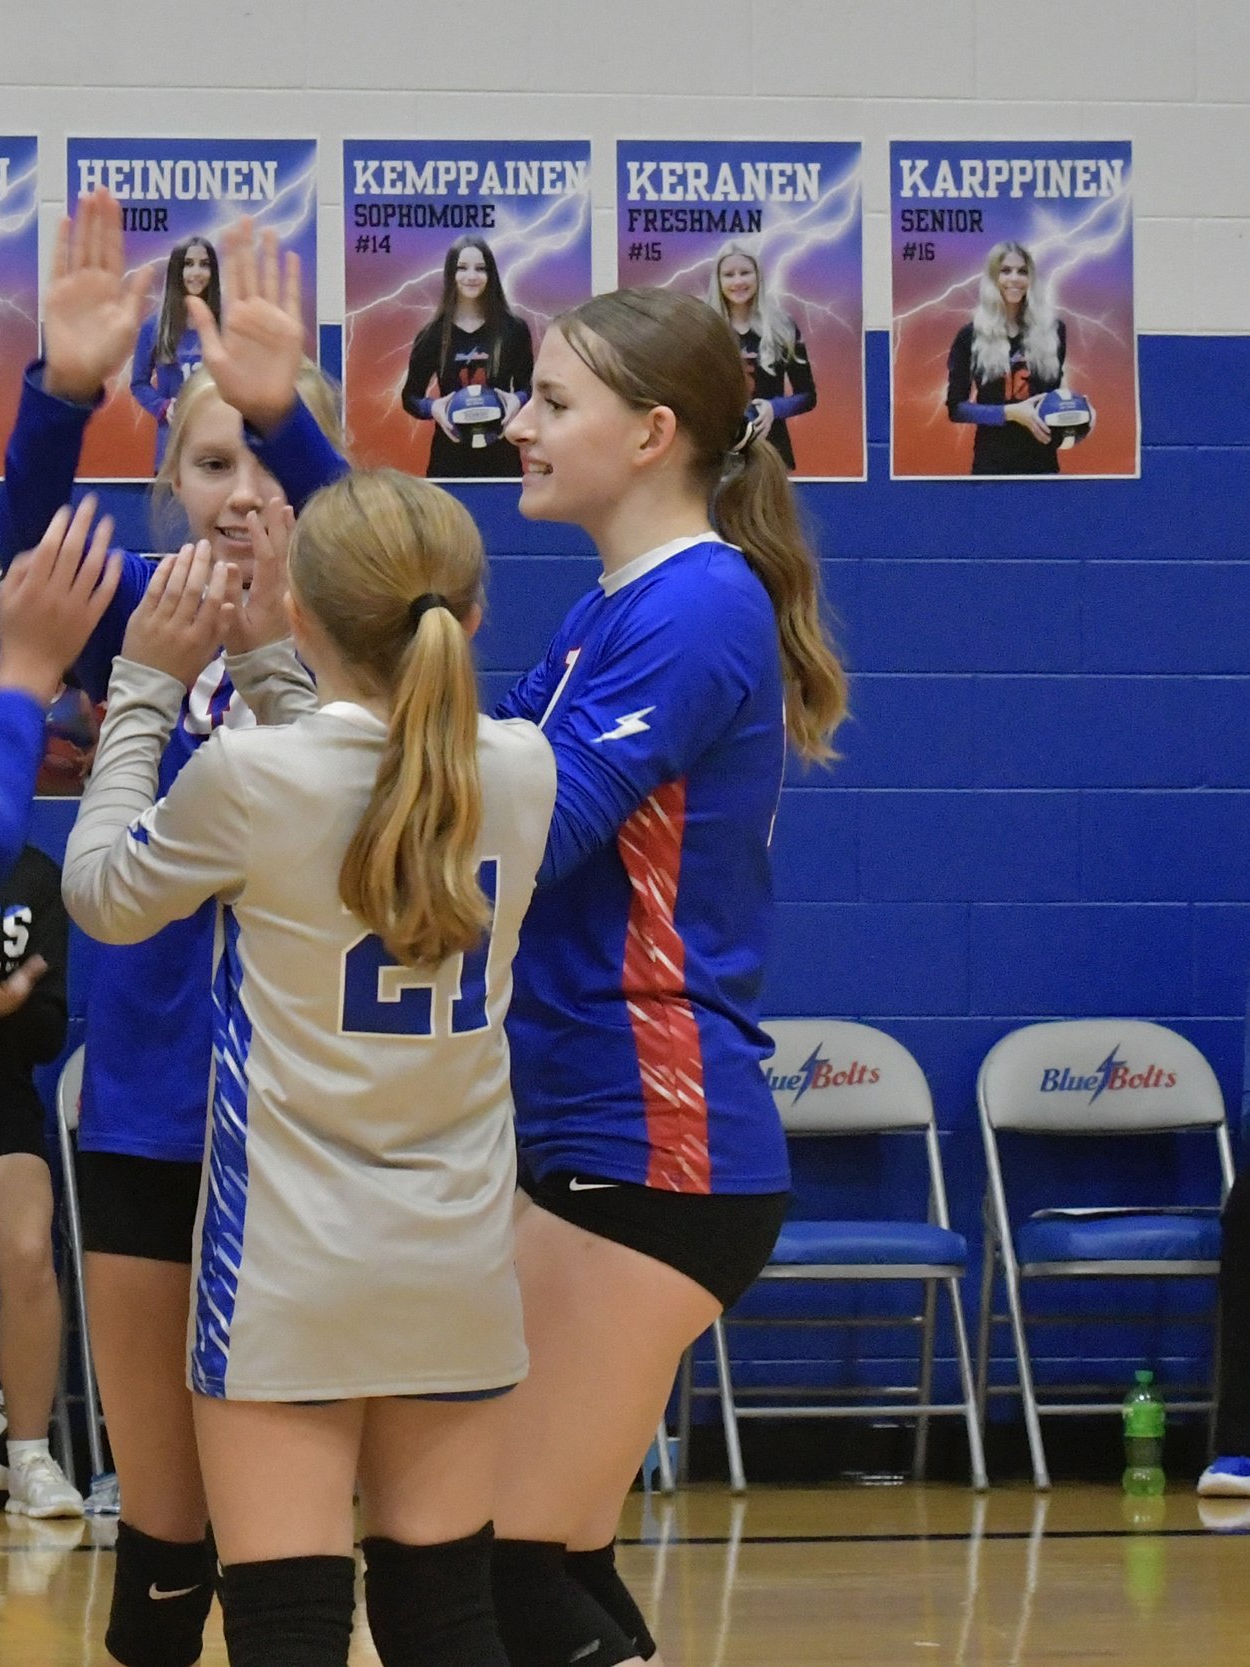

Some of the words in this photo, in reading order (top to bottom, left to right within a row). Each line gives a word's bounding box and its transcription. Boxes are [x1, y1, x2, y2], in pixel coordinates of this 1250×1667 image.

[77, 159, 278, 200] HEINONEN
[353, 160, 588, 195] KEMPPAINEN
[627, 161, 821, 201] KERANEN
[900, 159, 1124, 198] KARPPINEN
[354, 203, 496, 229] SOPHOMORE
[628, 208, 763, 233] FRESHMAN
[901, 209, 984, 233] SENIOR
[355, 235, 391, 254] #14
[628, 242, 662, 262] #15
[902, 242, 936, 262] #16
[337, 856, 500, 1039] 21
[811, 1060, 881, 1090] Bolts
[1040, 1067, 1100, 1092] Blue
[1107, 1063, 1178, 1091] Bolts
